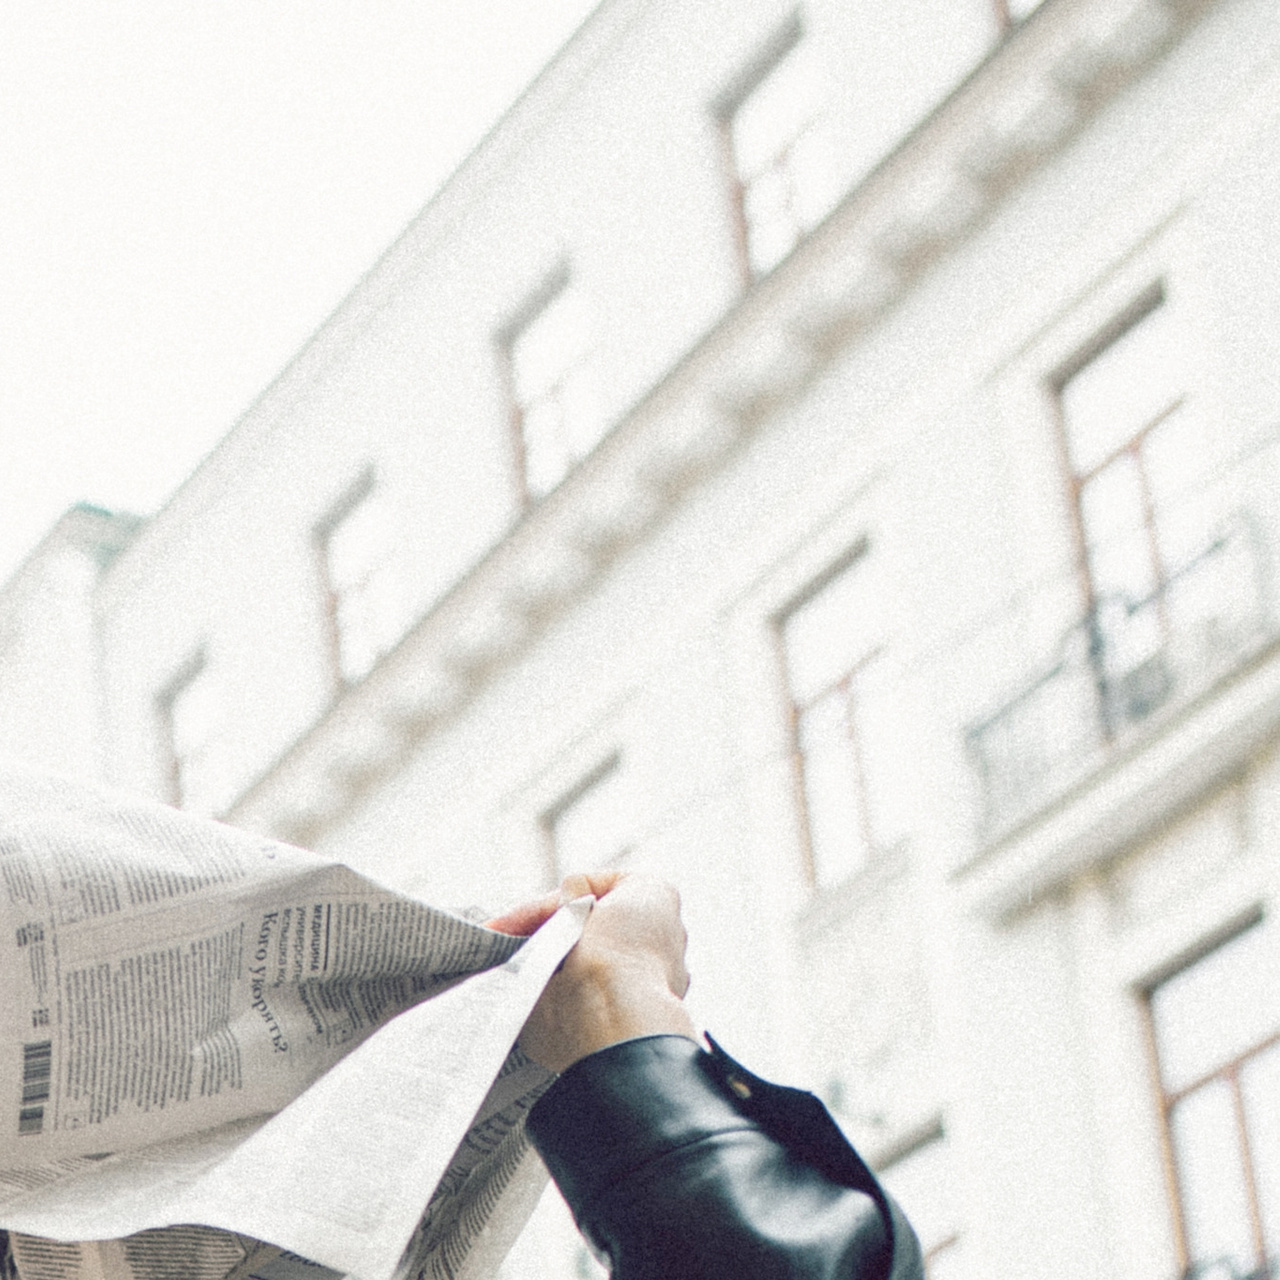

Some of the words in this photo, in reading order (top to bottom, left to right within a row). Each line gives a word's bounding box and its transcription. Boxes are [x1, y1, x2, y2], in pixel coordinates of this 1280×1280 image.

[255, 912, 278, 961] Кого
[310, 904, 322, 971] МЕДИЦИНА
[249, 966, 288, 1053] укорять?
